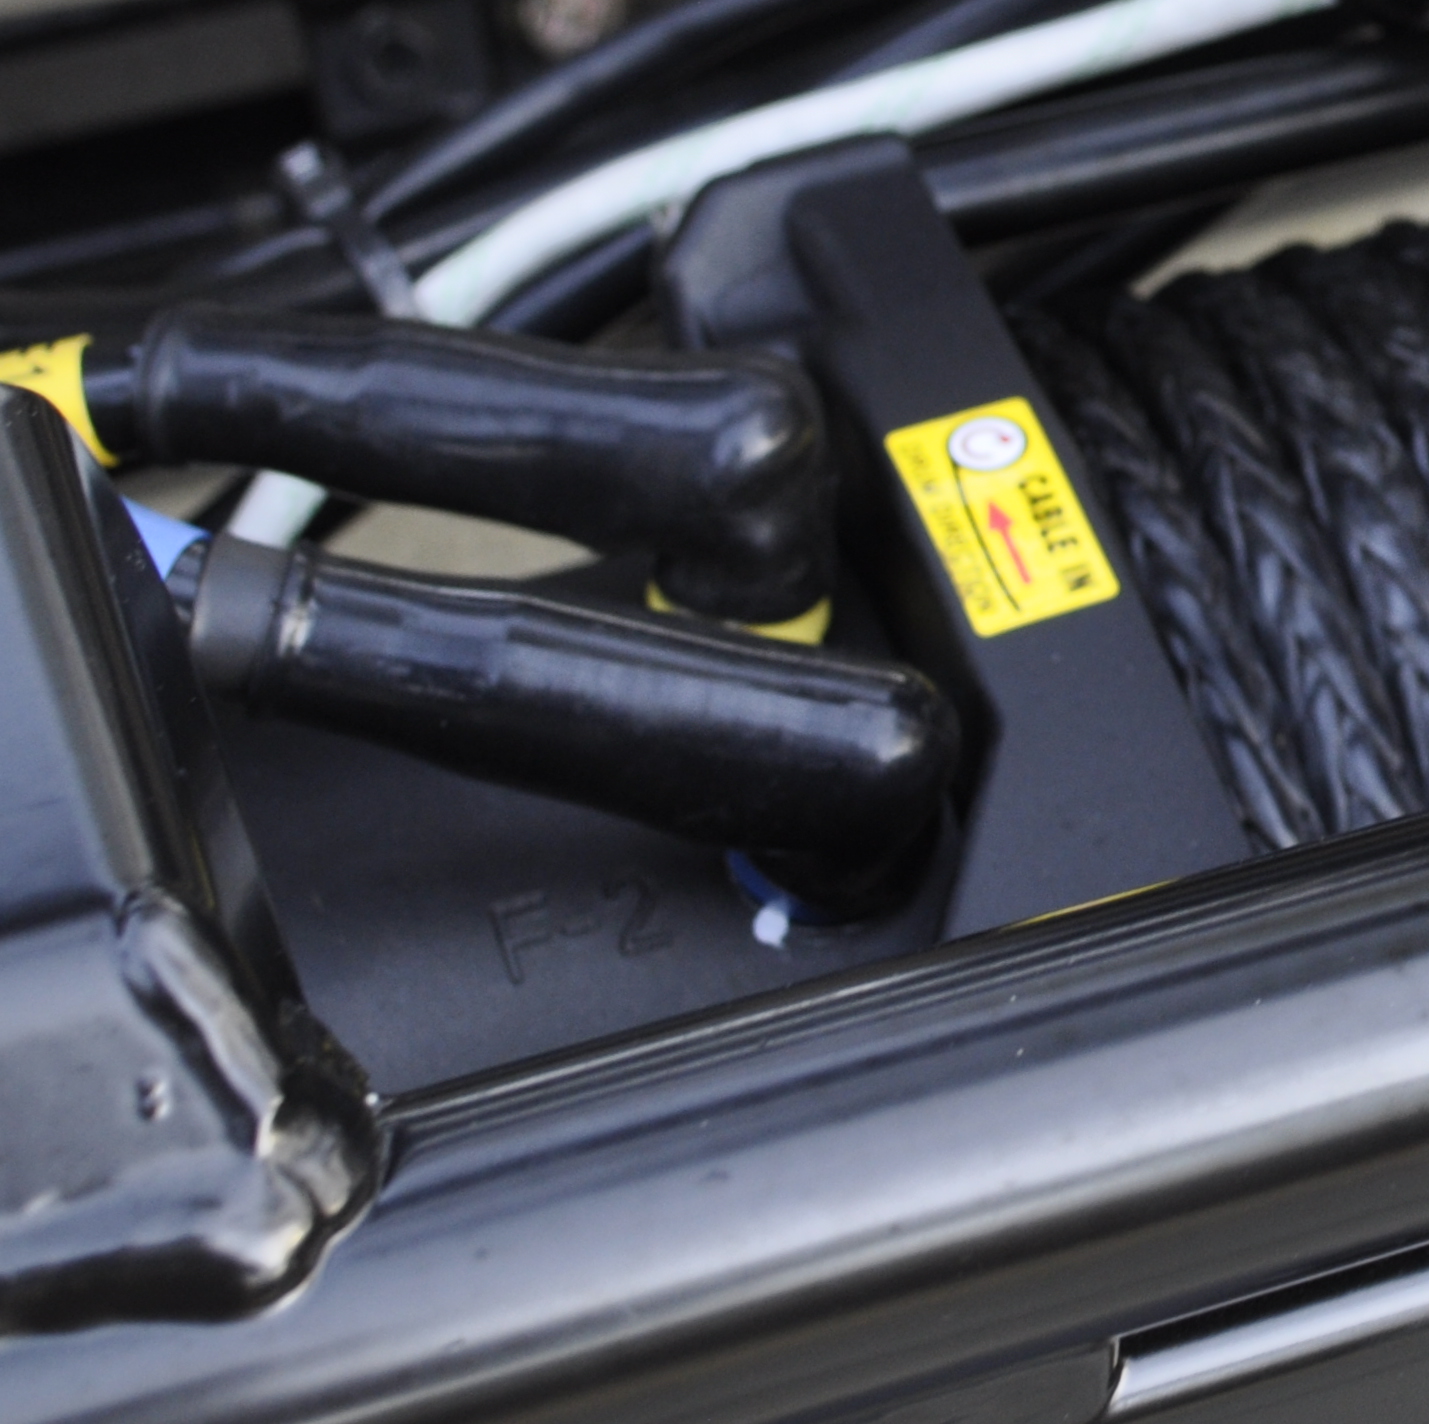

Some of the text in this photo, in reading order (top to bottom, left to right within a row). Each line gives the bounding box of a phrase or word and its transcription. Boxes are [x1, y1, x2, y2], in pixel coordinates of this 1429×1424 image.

[1018, 473, 1095, 593] CABLE IN
[488, 875, 677, 986] F-2
